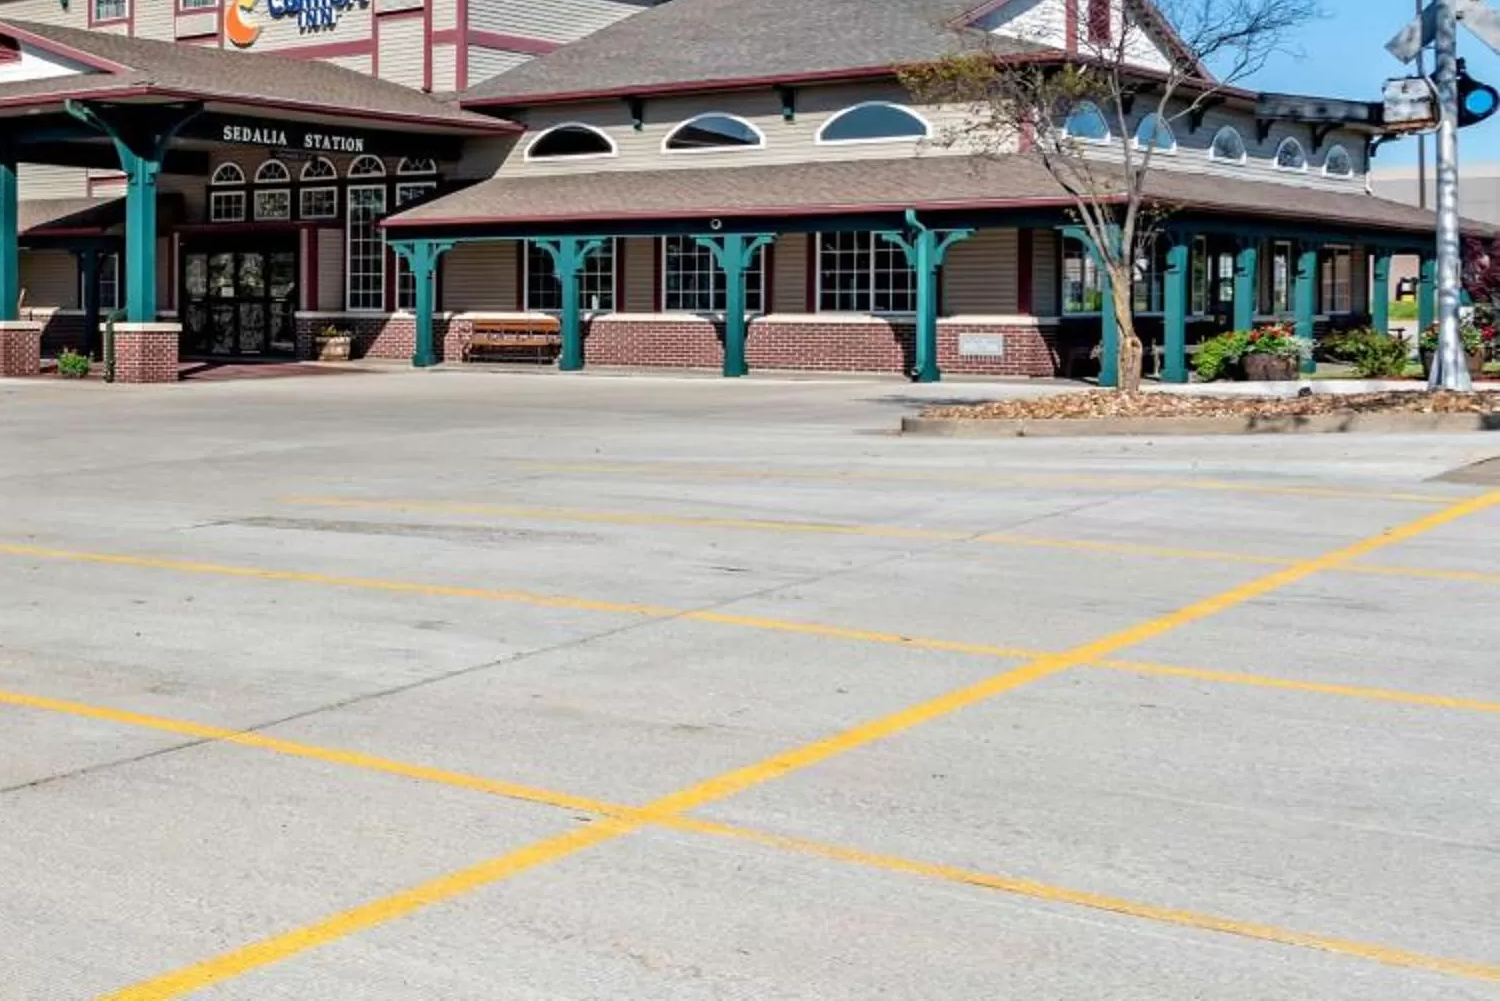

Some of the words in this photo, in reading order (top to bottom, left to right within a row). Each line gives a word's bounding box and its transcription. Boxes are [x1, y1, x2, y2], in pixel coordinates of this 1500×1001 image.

[297, 6, 336, 29] INN
[223, 125, 287, 145] SEDALIA
[304, 133, 364, 151] STATION
